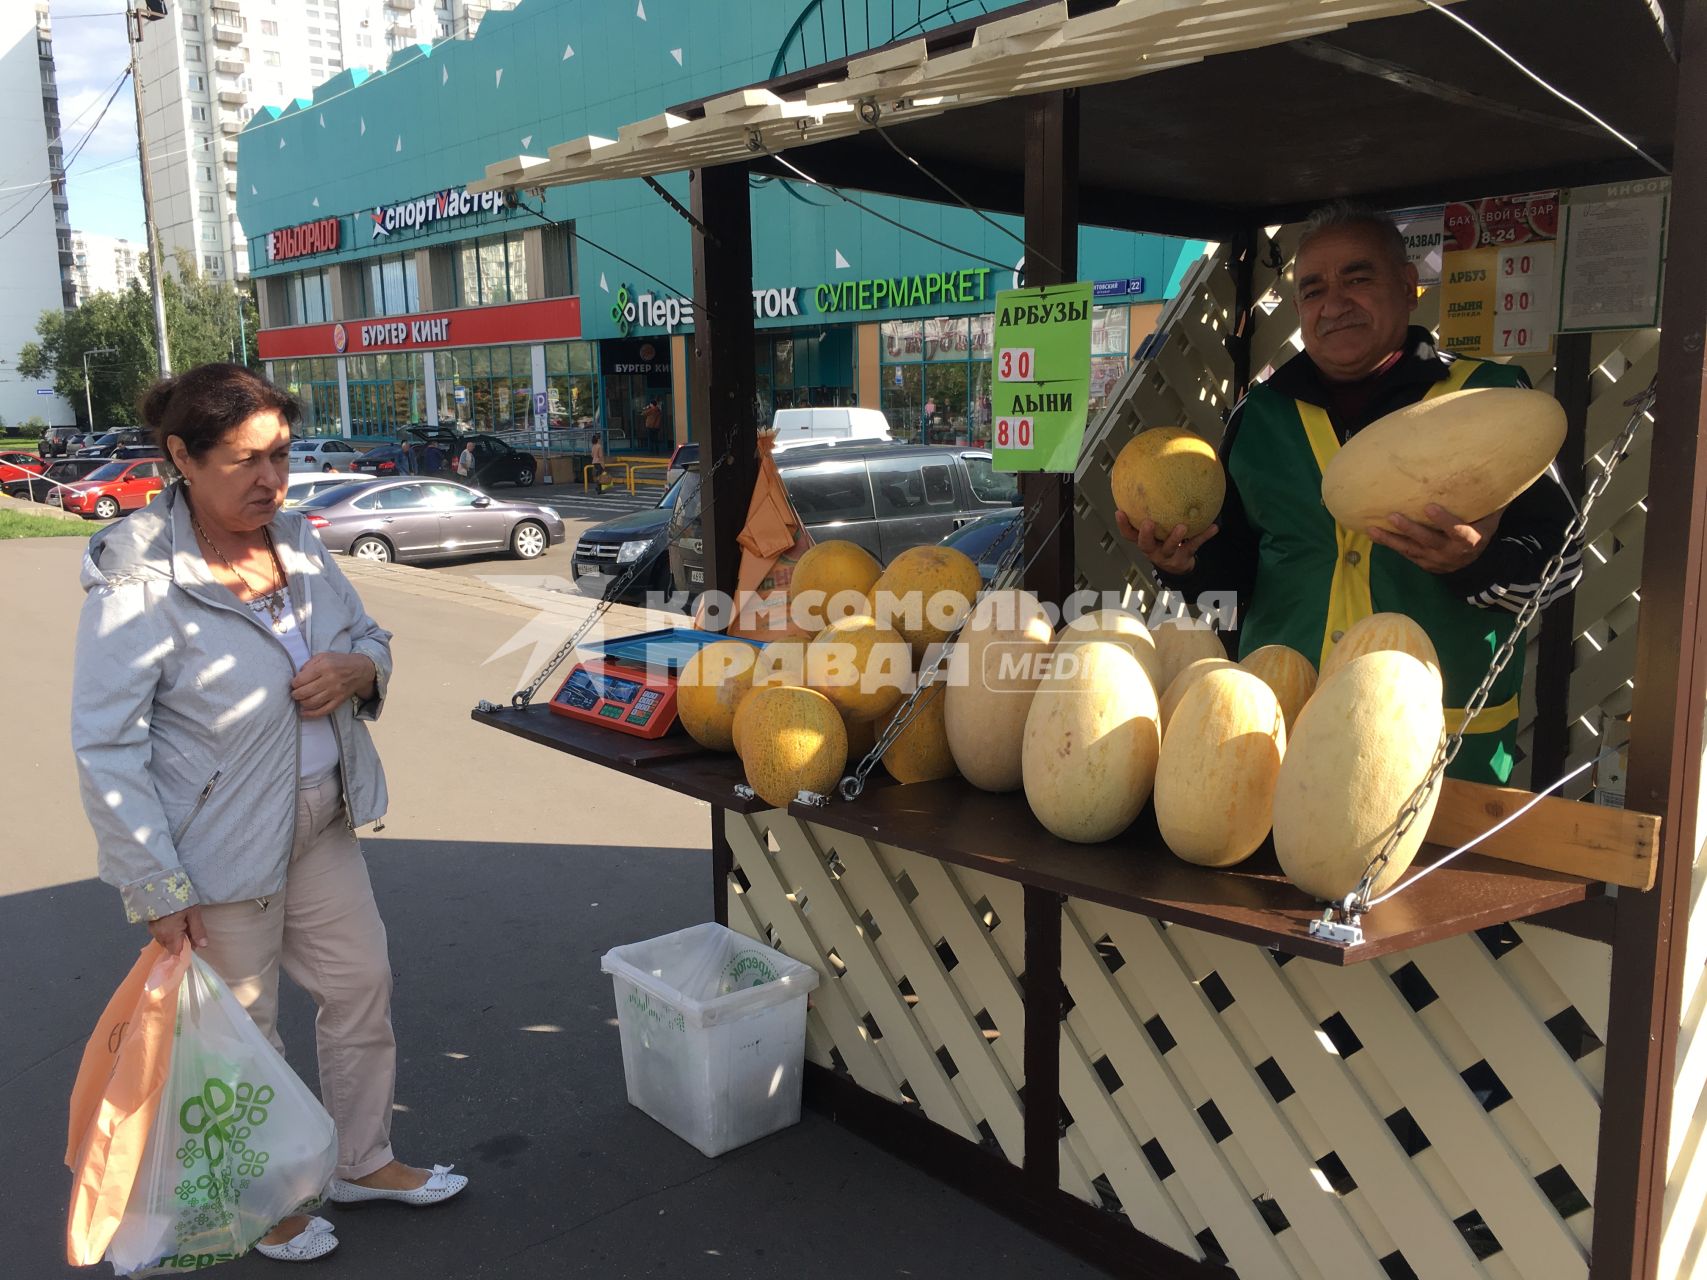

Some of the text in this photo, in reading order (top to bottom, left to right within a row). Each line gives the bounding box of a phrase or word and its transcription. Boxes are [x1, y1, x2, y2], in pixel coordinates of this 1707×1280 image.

[1607, 181, 1669, 196] ИНФОР
[1514, 204, 1554, 218] БАЗАР
[1400, 232, 1441, 248] РАЗВАЛ
[1481, 228, 1516, 244] 8-24
[1505, 256, 1531, 276] 30
[1131, 281, 1140, 291] 22
[1450, 269, 1487, 285] АРБУЗ
[815, 267, 991, 313] СУПЕРМАРКЕТ
[1503, 292, 1530, 311] 80
[999, 300, 1089, 327] АРБУЗЫ
[361, 322, 407, 347] БУРГЕР
[411, 318, 450, 343] КИНГ
[1502, 328, 1528, 348] 70
[615, 363, 670, 373] БУРГЕР КИ
[1001, 351, 1030, 379] 30
[1011, 393, 1073, 415] ДЫНИ
[997, 419, 1031, 447] 80
